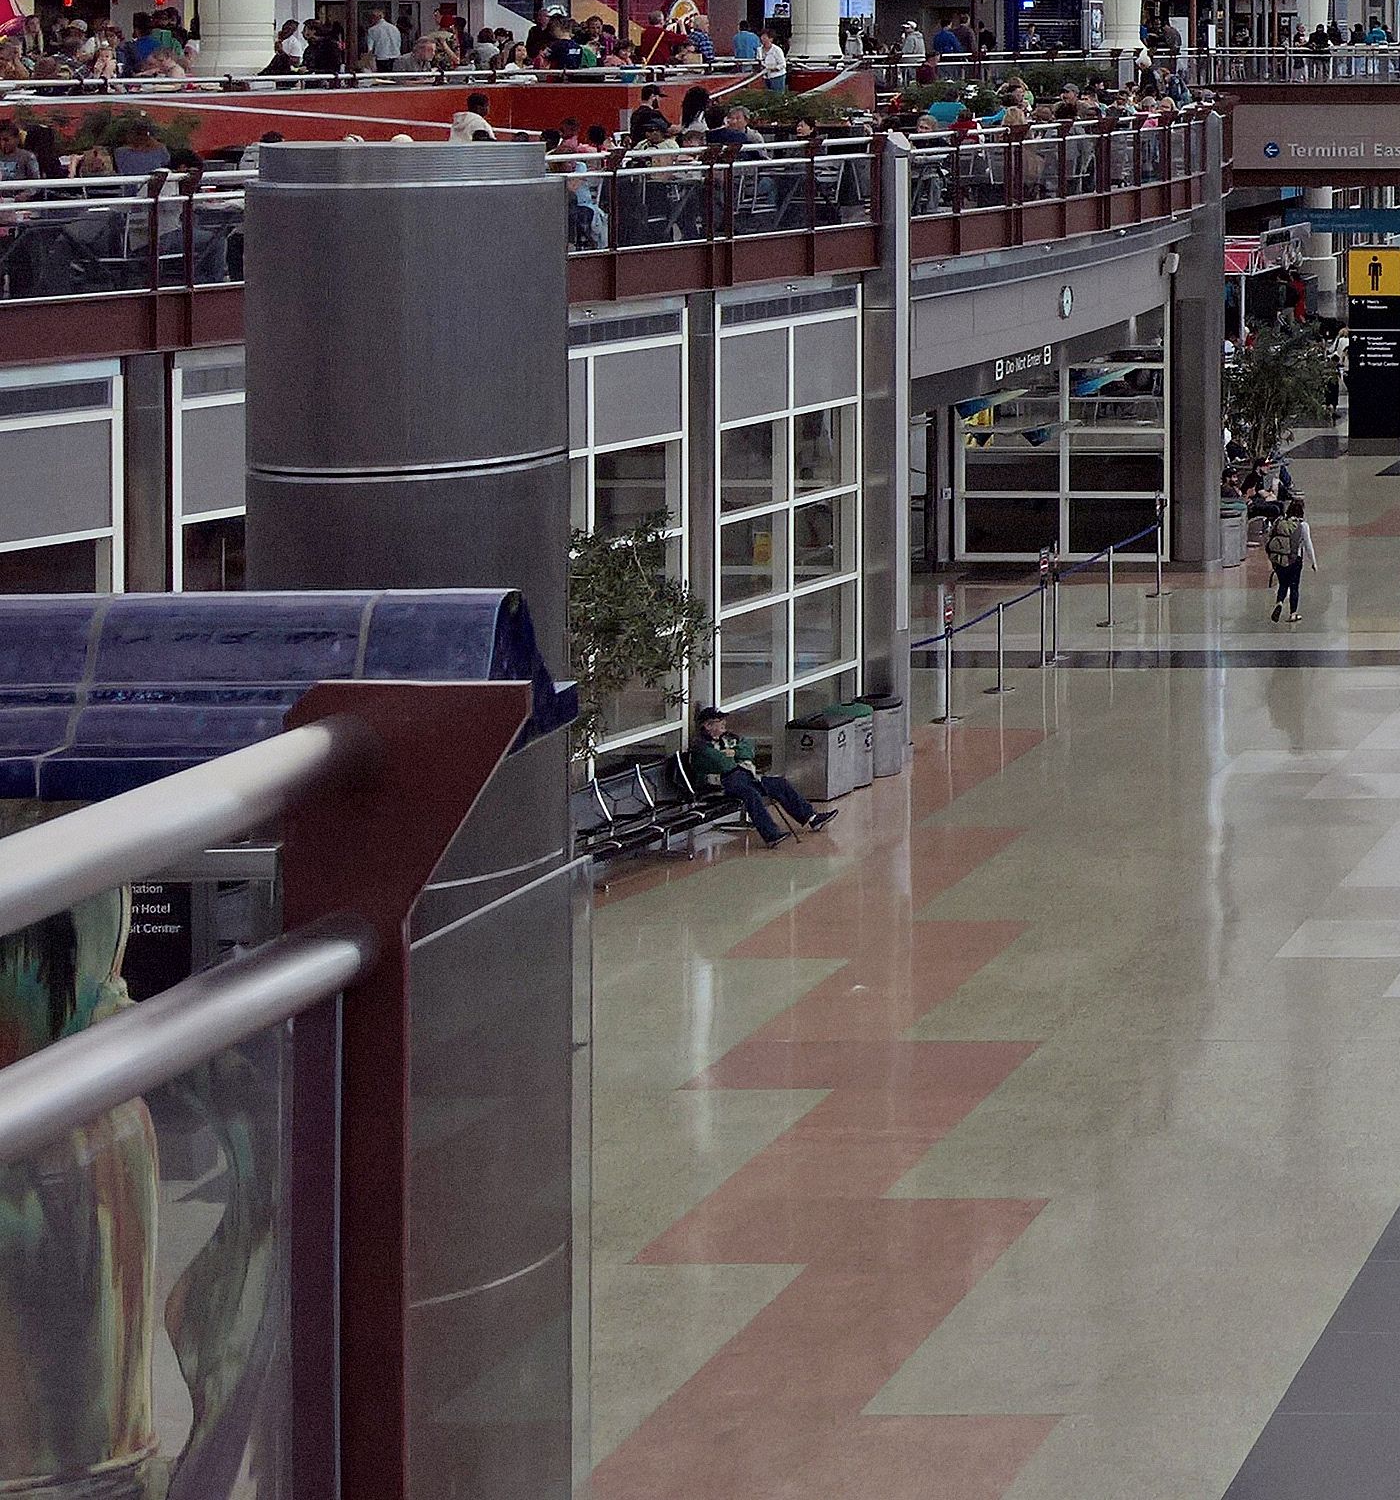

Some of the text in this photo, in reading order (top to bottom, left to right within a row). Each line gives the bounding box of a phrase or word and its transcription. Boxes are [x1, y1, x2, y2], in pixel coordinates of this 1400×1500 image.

[1287, 142, 1365, 157] Terminal
[1005, 353, 1042, 375] Do Not Enter
[141, 902, 171, 914] Hotel
[143, 923, 182, 934] Center
